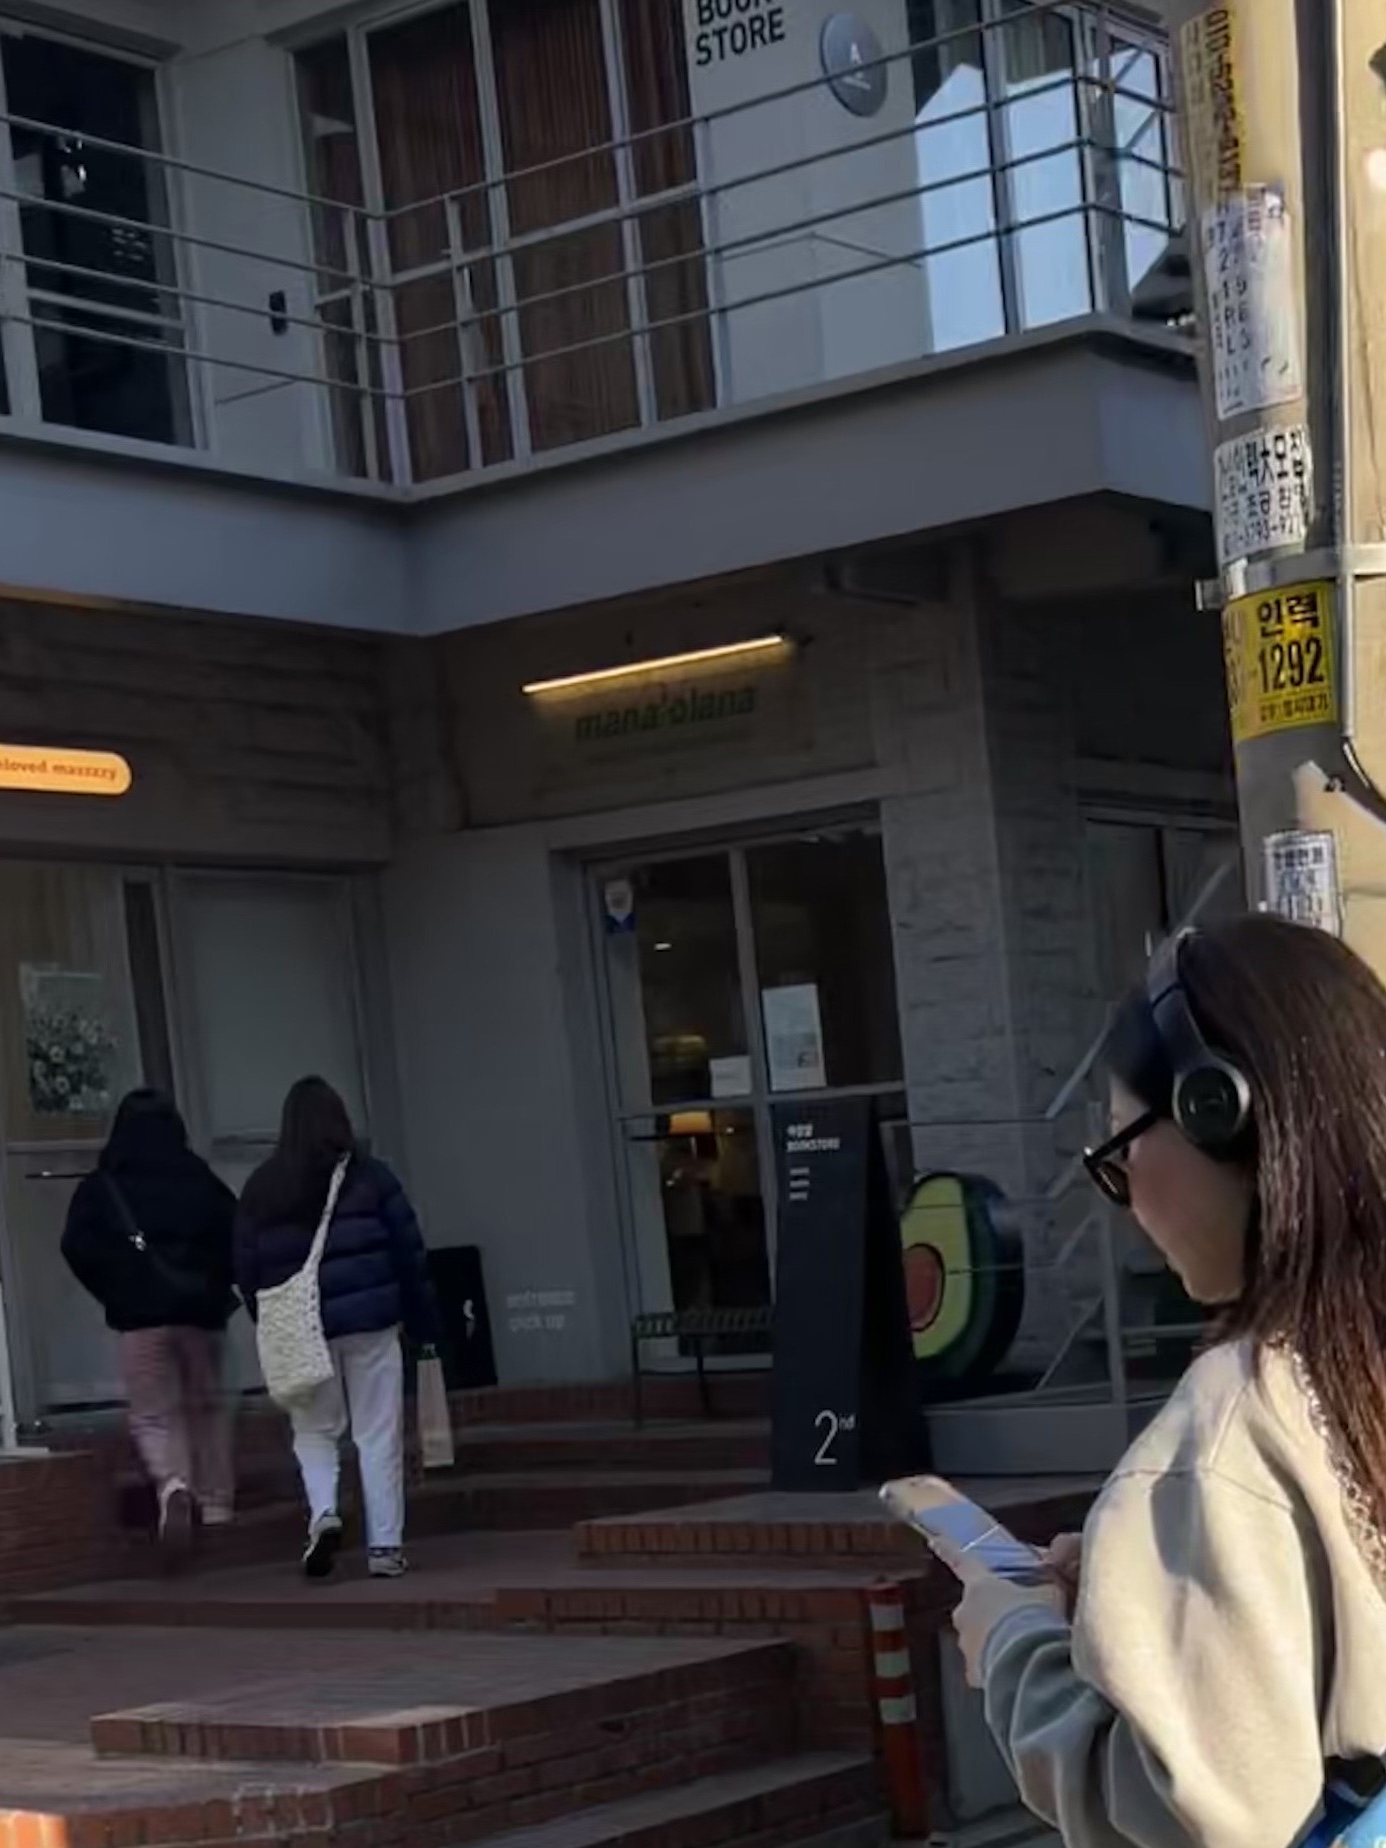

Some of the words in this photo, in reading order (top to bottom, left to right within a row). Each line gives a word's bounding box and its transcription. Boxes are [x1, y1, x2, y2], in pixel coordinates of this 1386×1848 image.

[696, 0, 773, 26] BO
[696, 7, 785, 66] STORE
[1258, 592, 1320, 638] 인력
[1258, 636, 1324, 693] 1292
[0, 758, 47, 774] loved
[814, 1409, 857, 1465] 2nd
